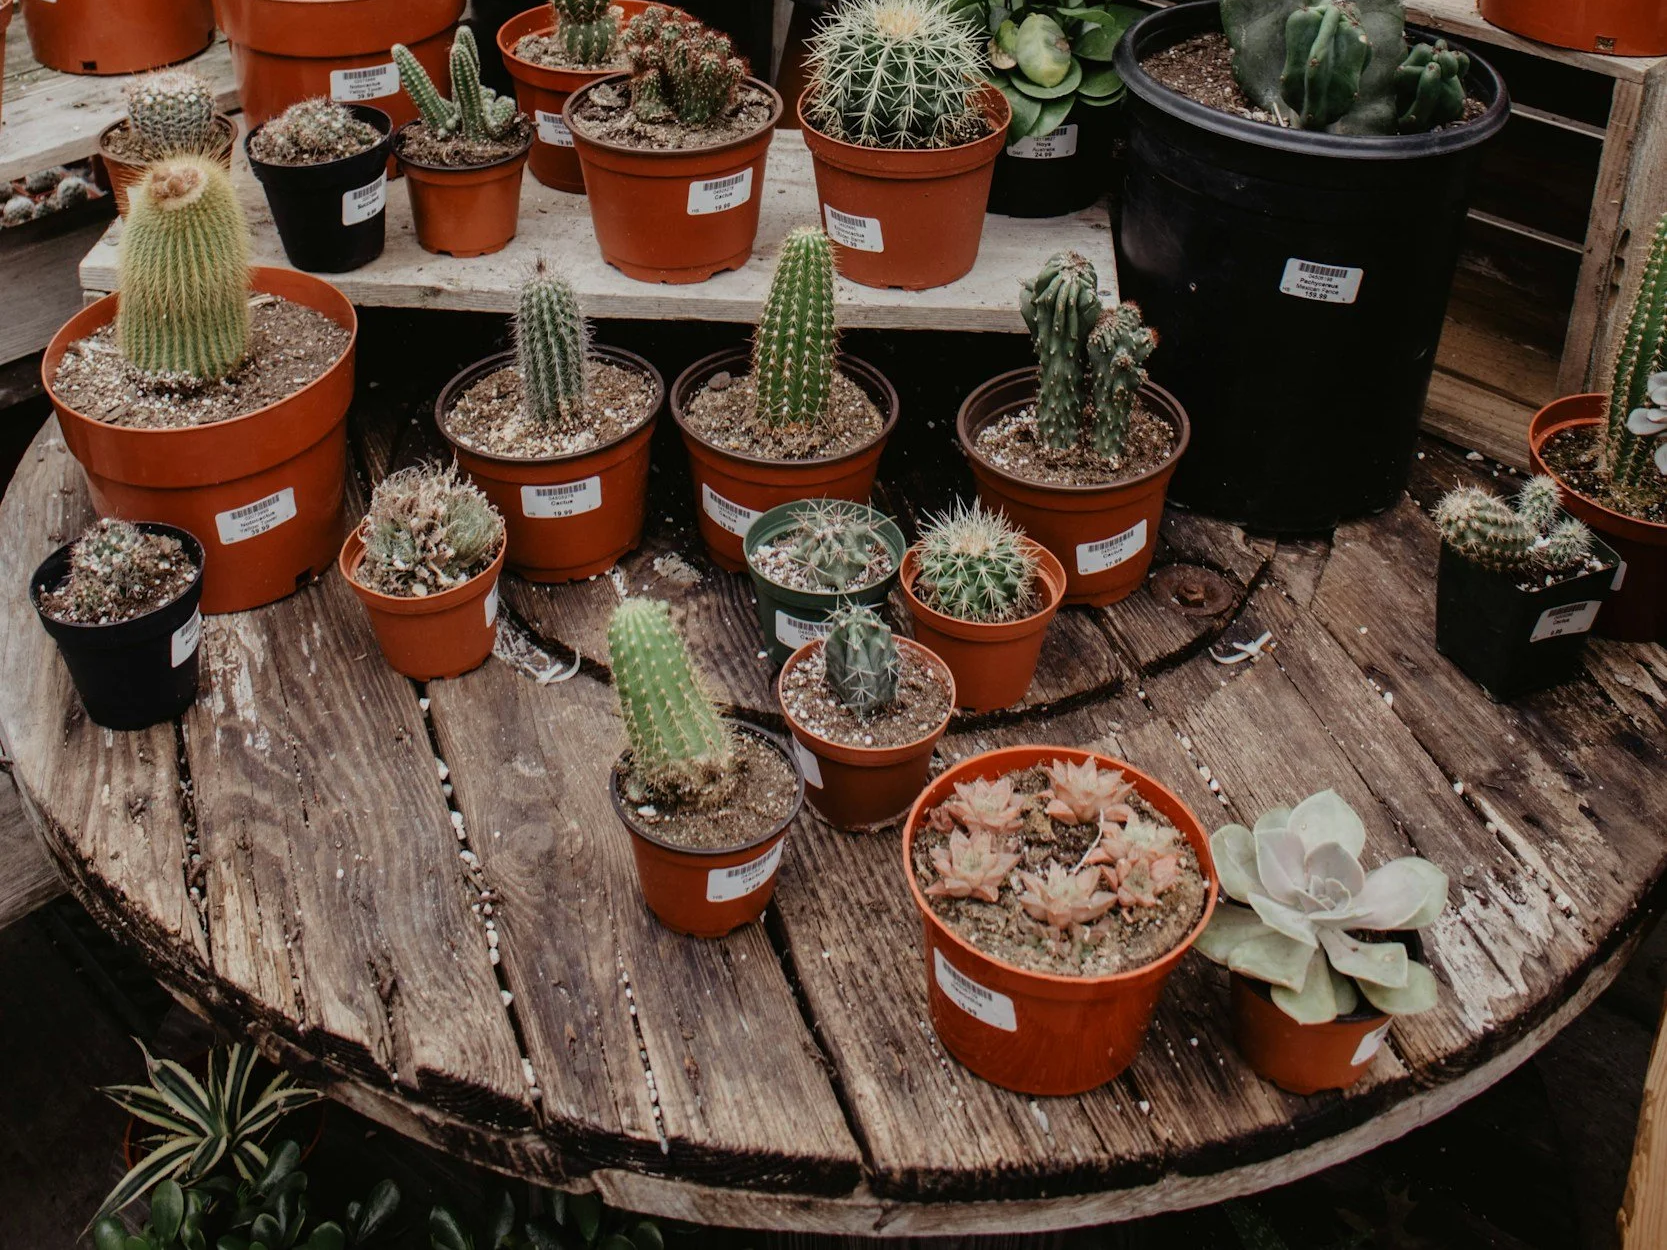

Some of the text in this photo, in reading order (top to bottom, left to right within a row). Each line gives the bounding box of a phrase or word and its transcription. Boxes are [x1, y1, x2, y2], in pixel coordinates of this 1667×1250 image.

[715, 192, 733, 200] Cactus
[357, 196, 379, 210] Succulent
[1296, 283, 1320, 292] Mexican
[1300, 277, 1339, 289] Pachycereus
[1305, 291, 1328, 299] 159.99
[241, 511, 275, 527] Notocactus
[719, 510, 736, 523] Cactus
[239, 516, 278, 533] Yellow Tower
[251, 524, 270, 535] 39.99
[720, 520, 735, 532] 19.99
[1103, 548, 1123, 558] Cactus
[743, 869, 765, 883] Cactus
